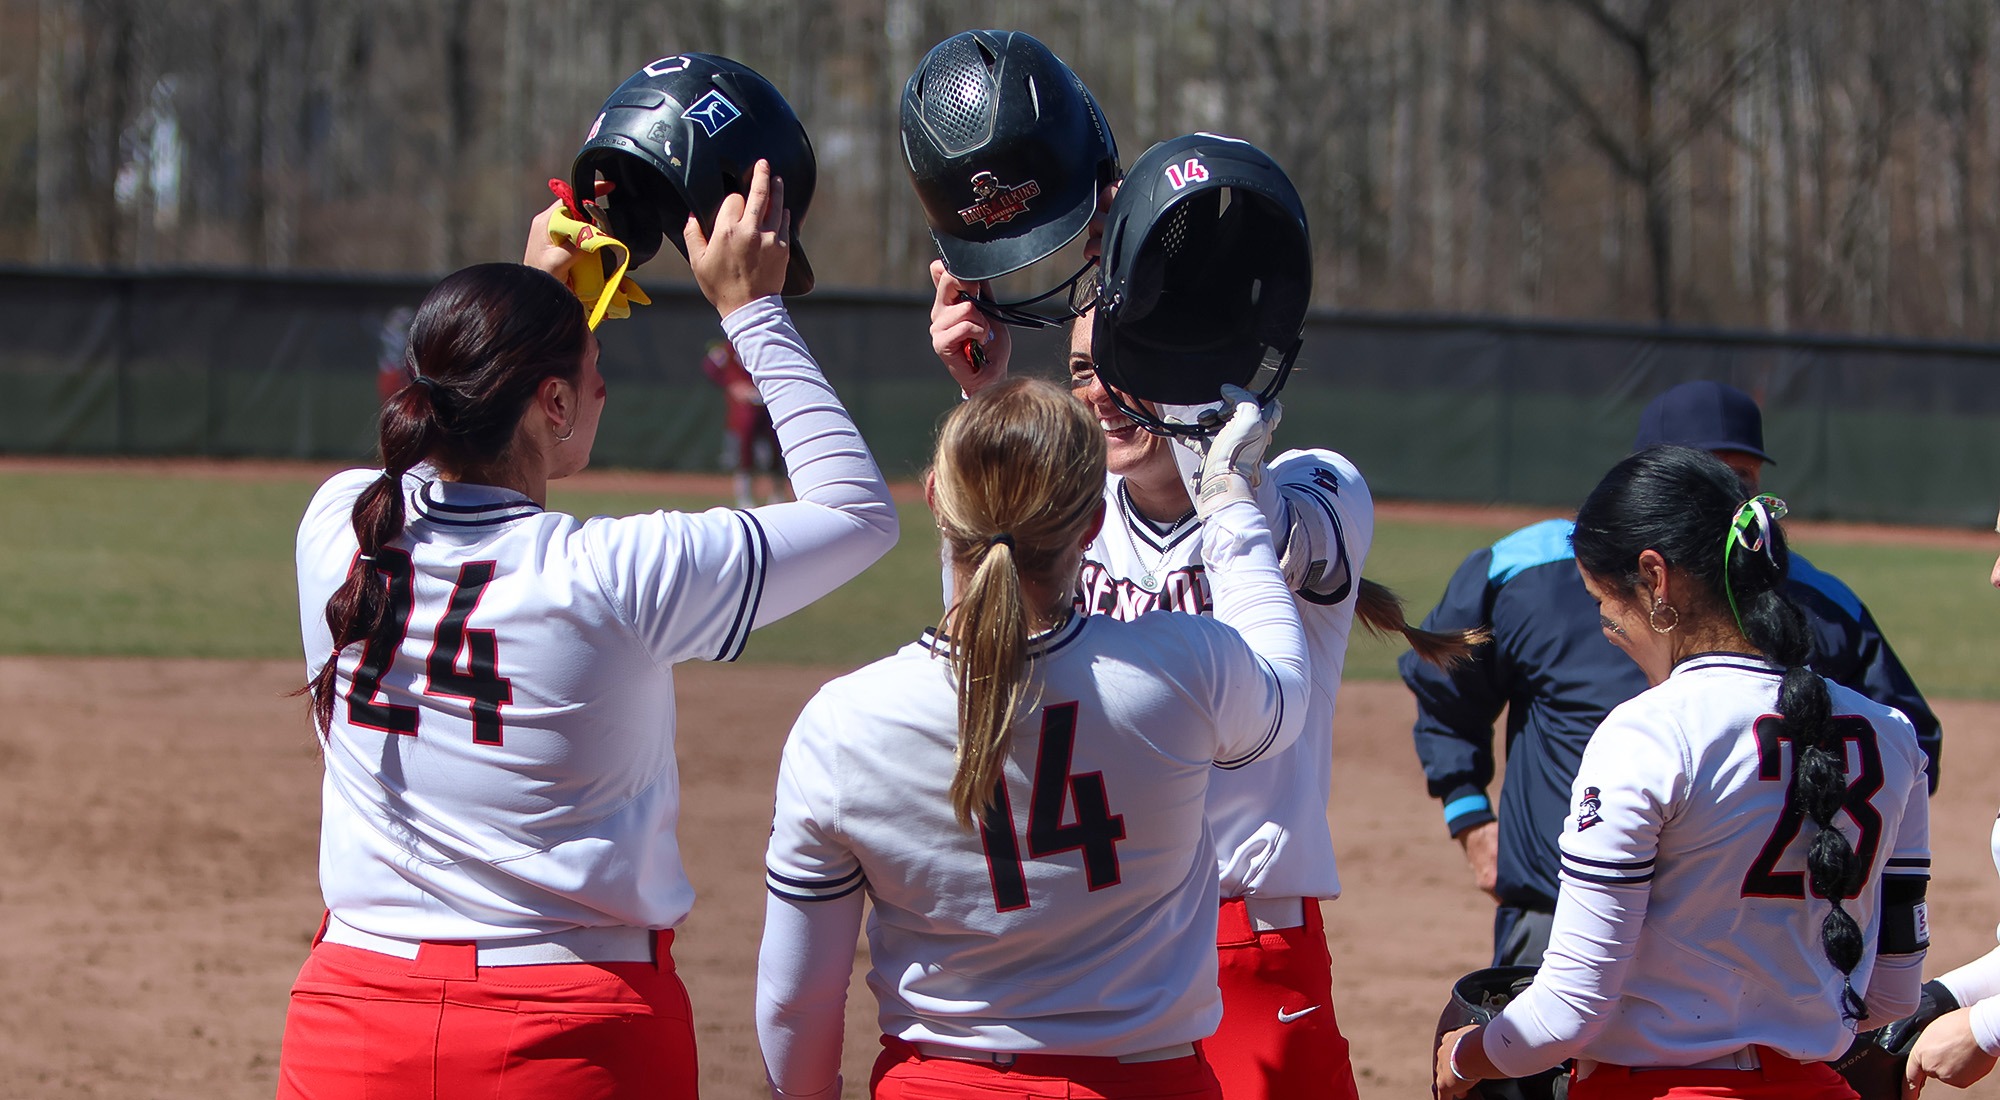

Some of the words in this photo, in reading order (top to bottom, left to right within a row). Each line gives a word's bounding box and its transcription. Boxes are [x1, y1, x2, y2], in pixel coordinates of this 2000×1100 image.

[961, 204, 992, 223] DAVIS
[1000, 183, 1038, 207] ELKINS
[1165, 158, 1209, 190] 14
[346, 545, 514, 747] 24
[977, 700, 1127, 914] 14
